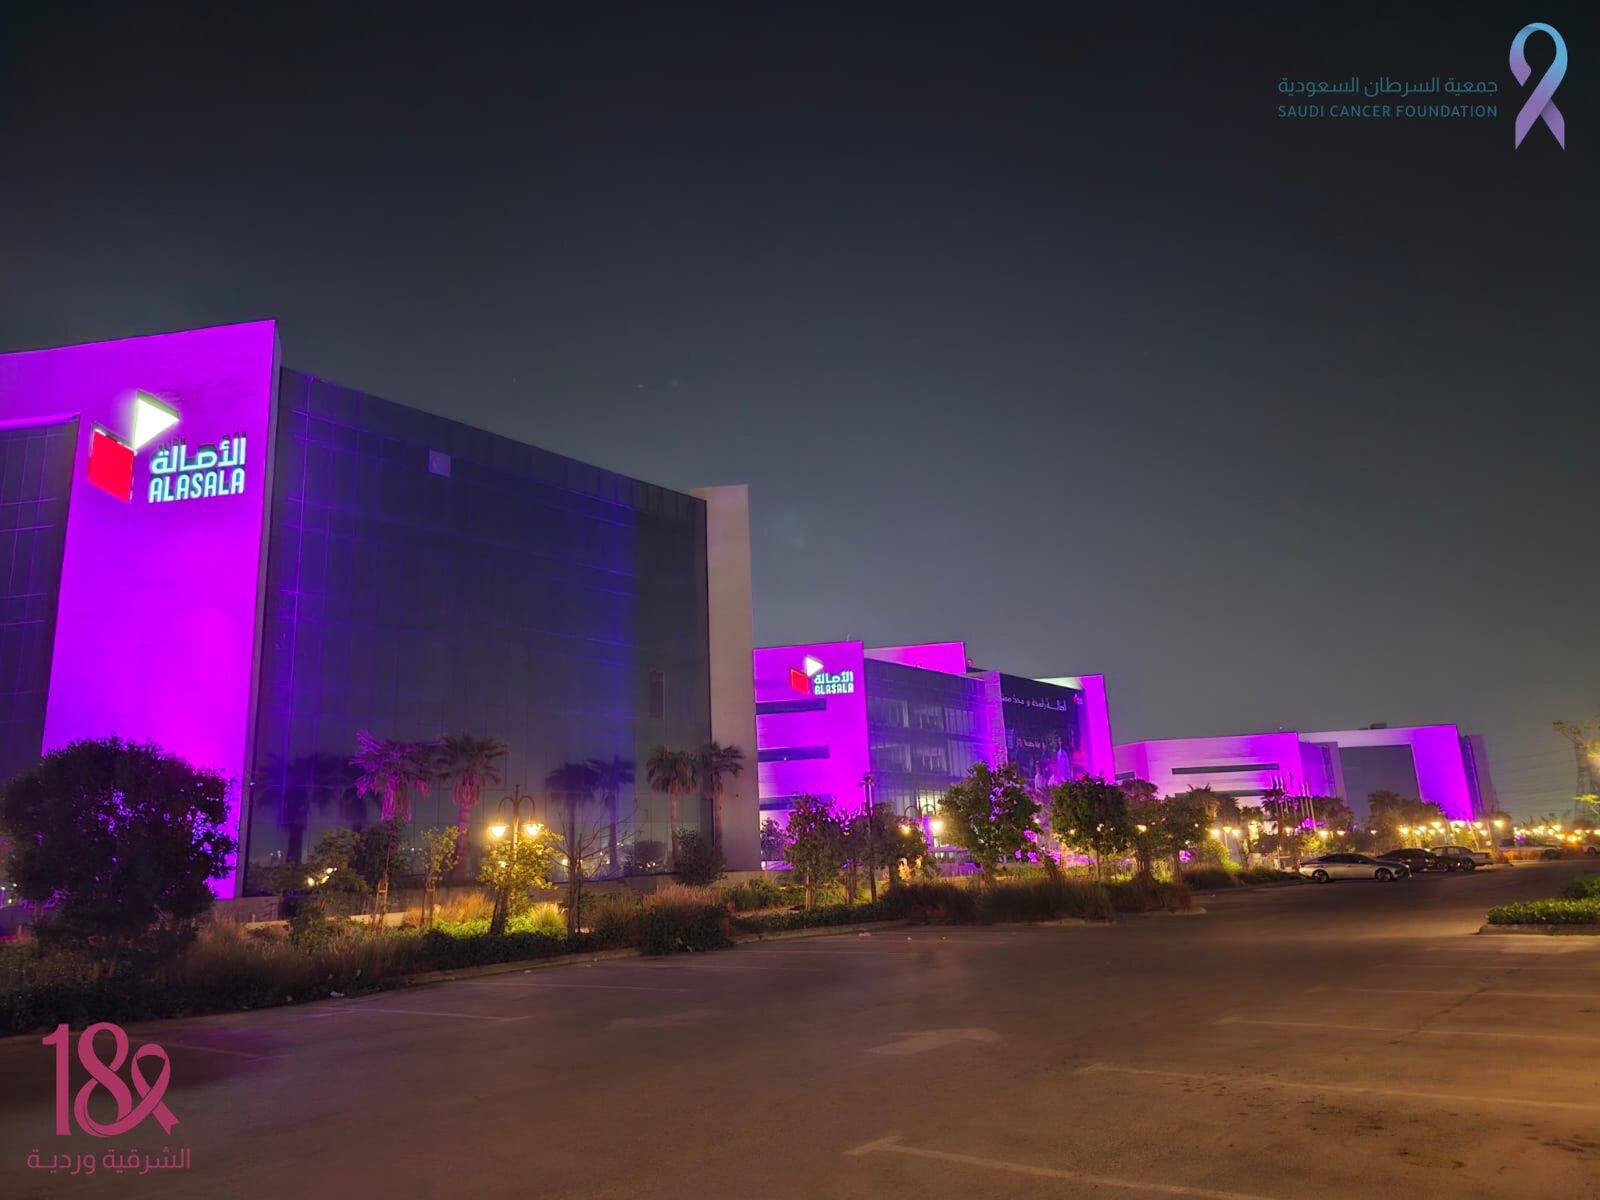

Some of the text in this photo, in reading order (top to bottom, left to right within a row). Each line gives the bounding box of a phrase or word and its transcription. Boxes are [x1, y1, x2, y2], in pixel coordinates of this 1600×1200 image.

[150, 437, 247, 475] الأصالة
[148, 468, 246, 504] ALASALA
[814, 682, 855, 695] ALASALA
